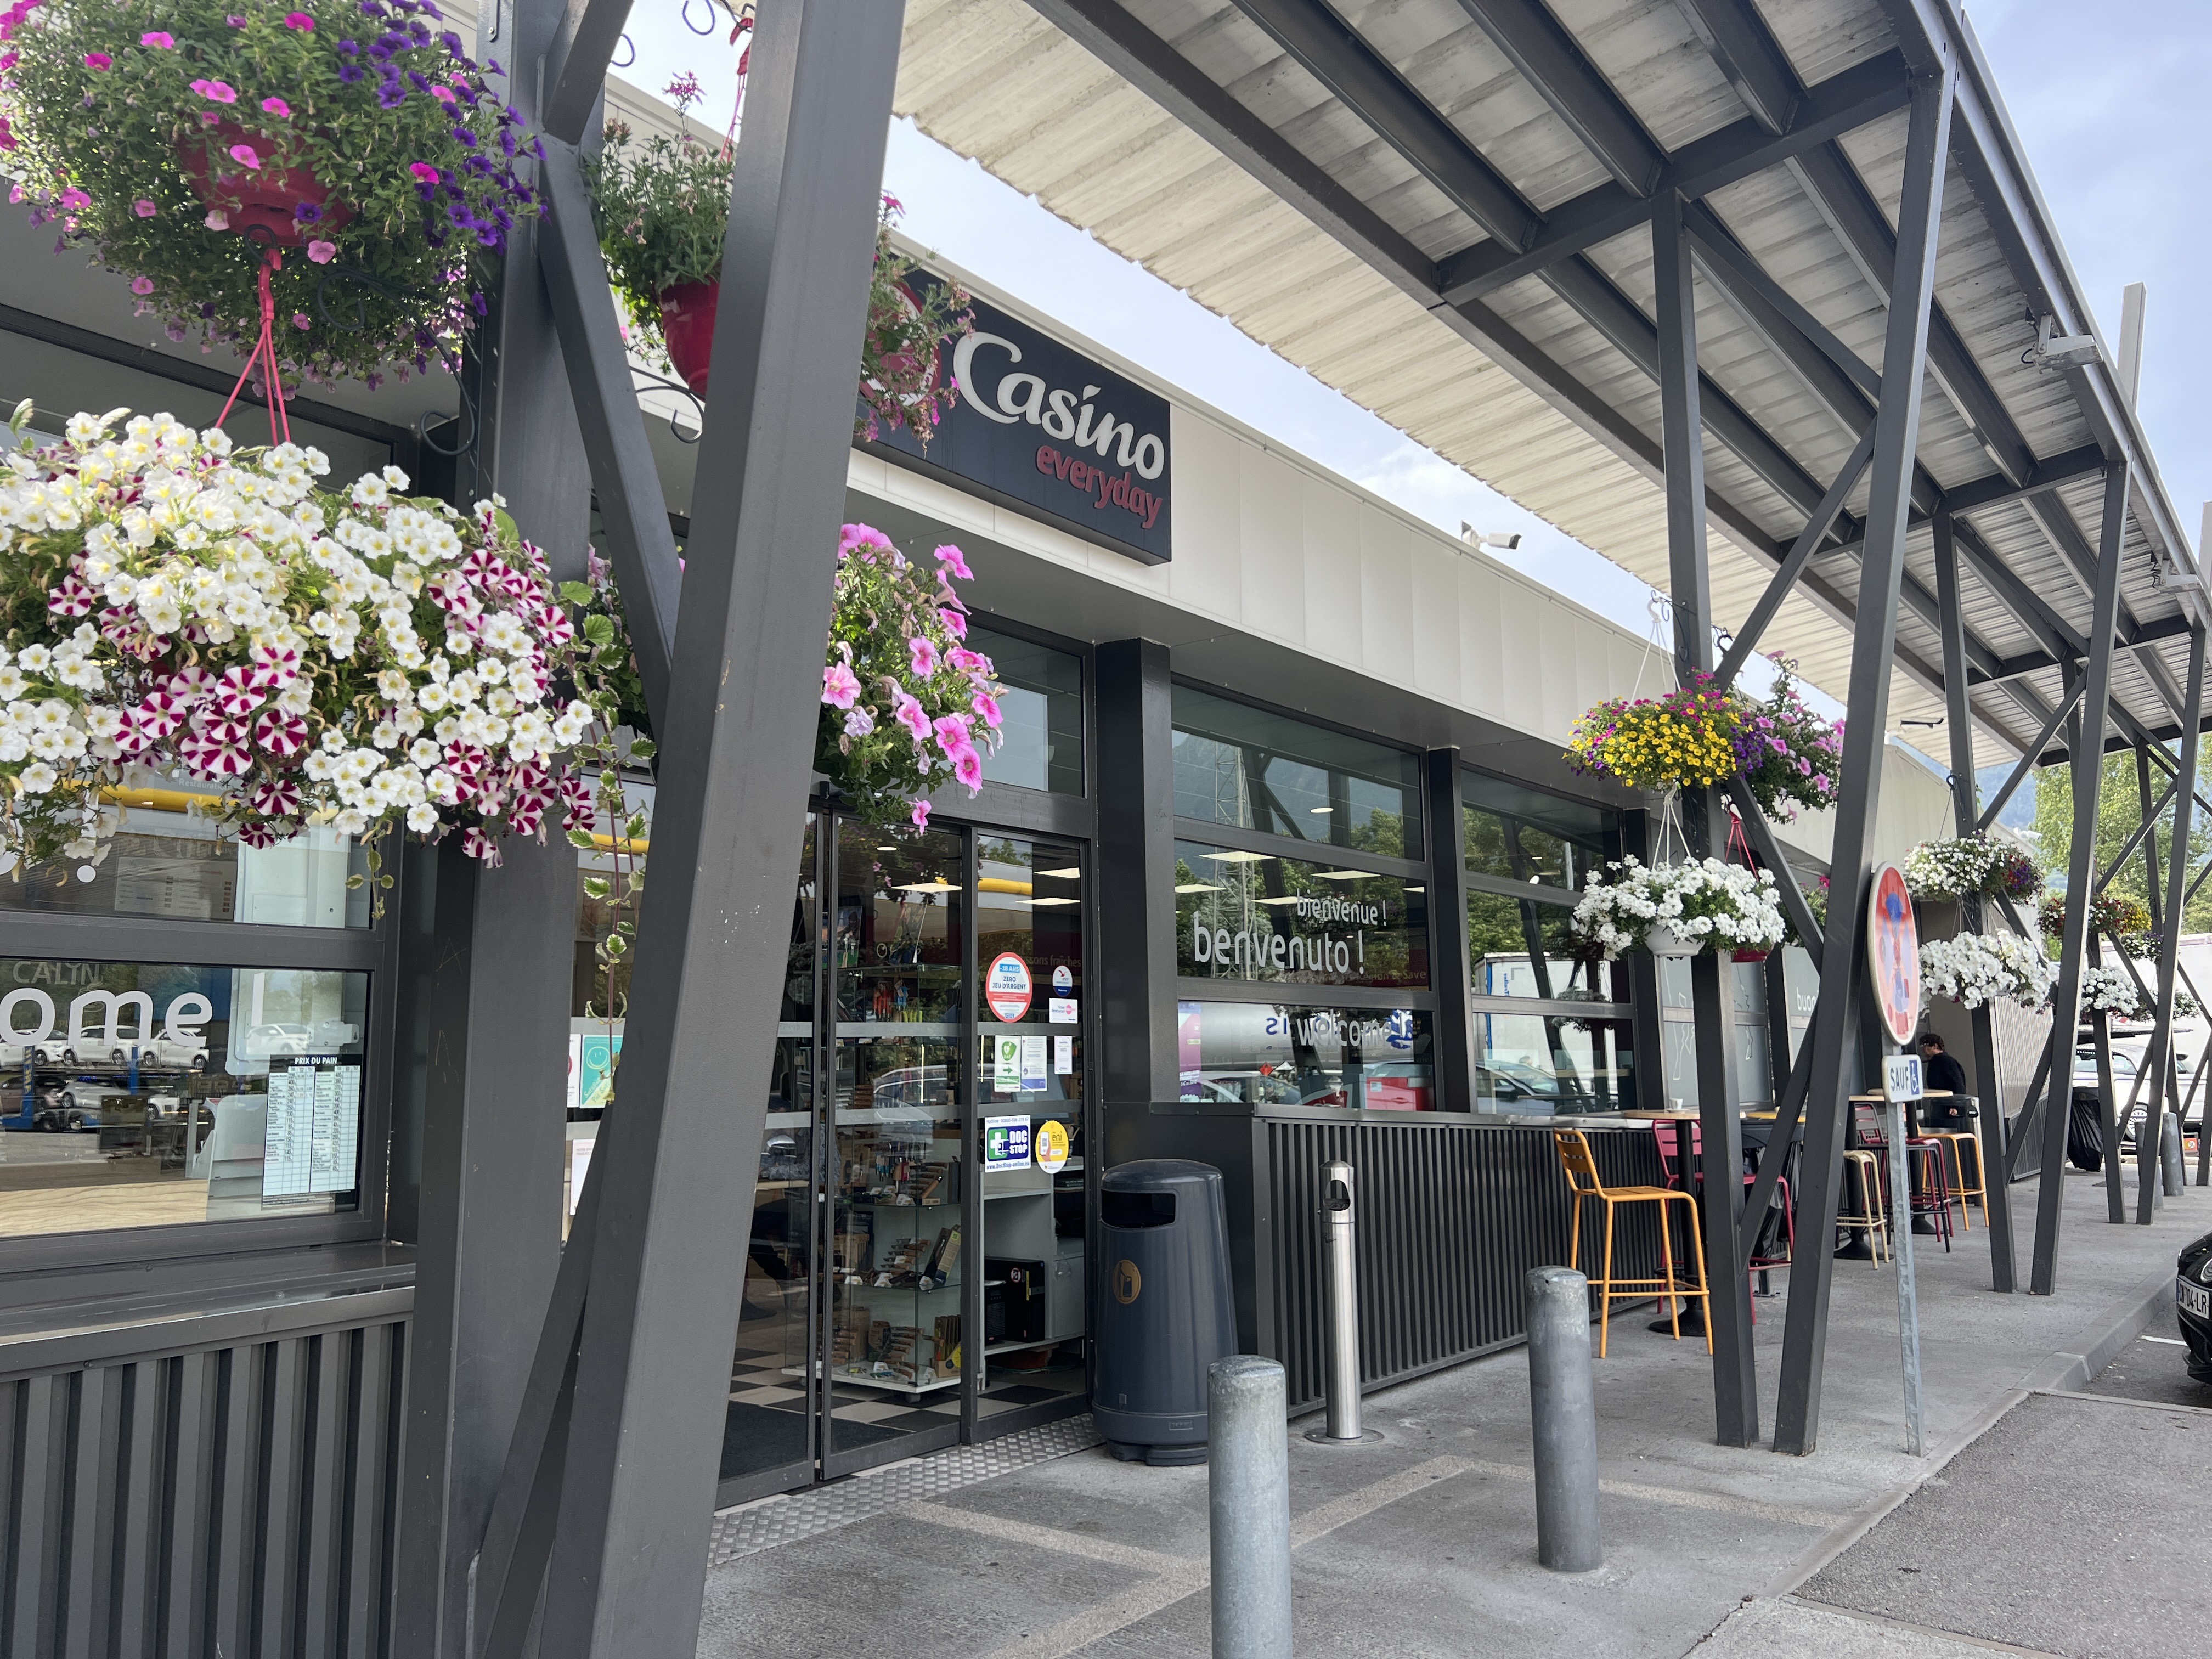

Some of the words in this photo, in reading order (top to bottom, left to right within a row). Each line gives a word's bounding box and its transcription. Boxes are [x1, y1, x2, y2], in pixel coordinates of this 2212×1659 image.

[952, 331, 1165, 480] Casino
[1036, 444, 1163, 529] everyday
[1296, 887, 1378, 925] bienvenue
[1193, 910, 1350, 974] benvenuto
[1296, 1008, 1392, 1047] welcome
[1890, 1063, 1909, 1092] SAUF
[1009, 1130, 1028, 1144] DOC
[1009, 1144, 1028, 1154] STOP
